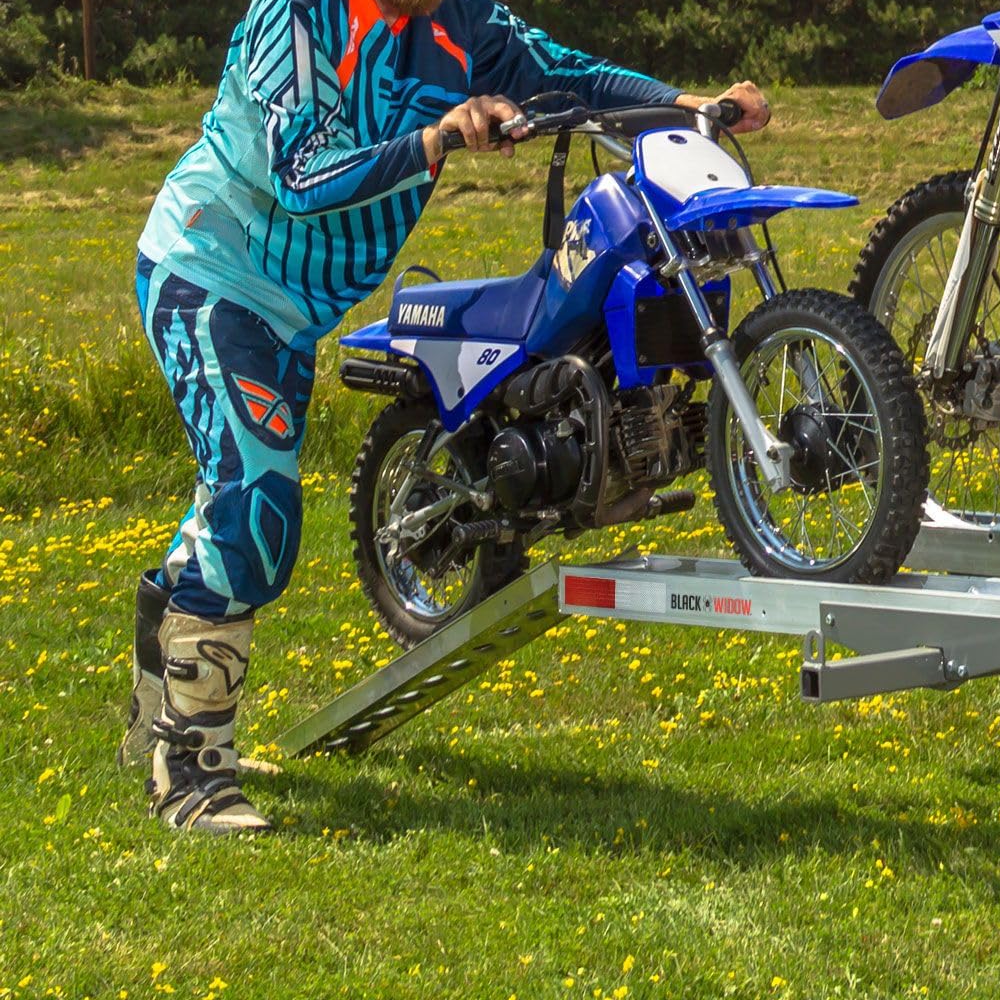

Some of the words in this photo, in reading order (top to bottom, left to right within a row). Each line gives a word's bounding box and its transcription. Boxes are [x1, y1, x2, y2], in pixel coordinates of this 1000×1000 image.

[397, 303, 446, 328] YAMAHA
[477, 348, 501, 366] 80
[671, 593, 701, 612] BLACK
